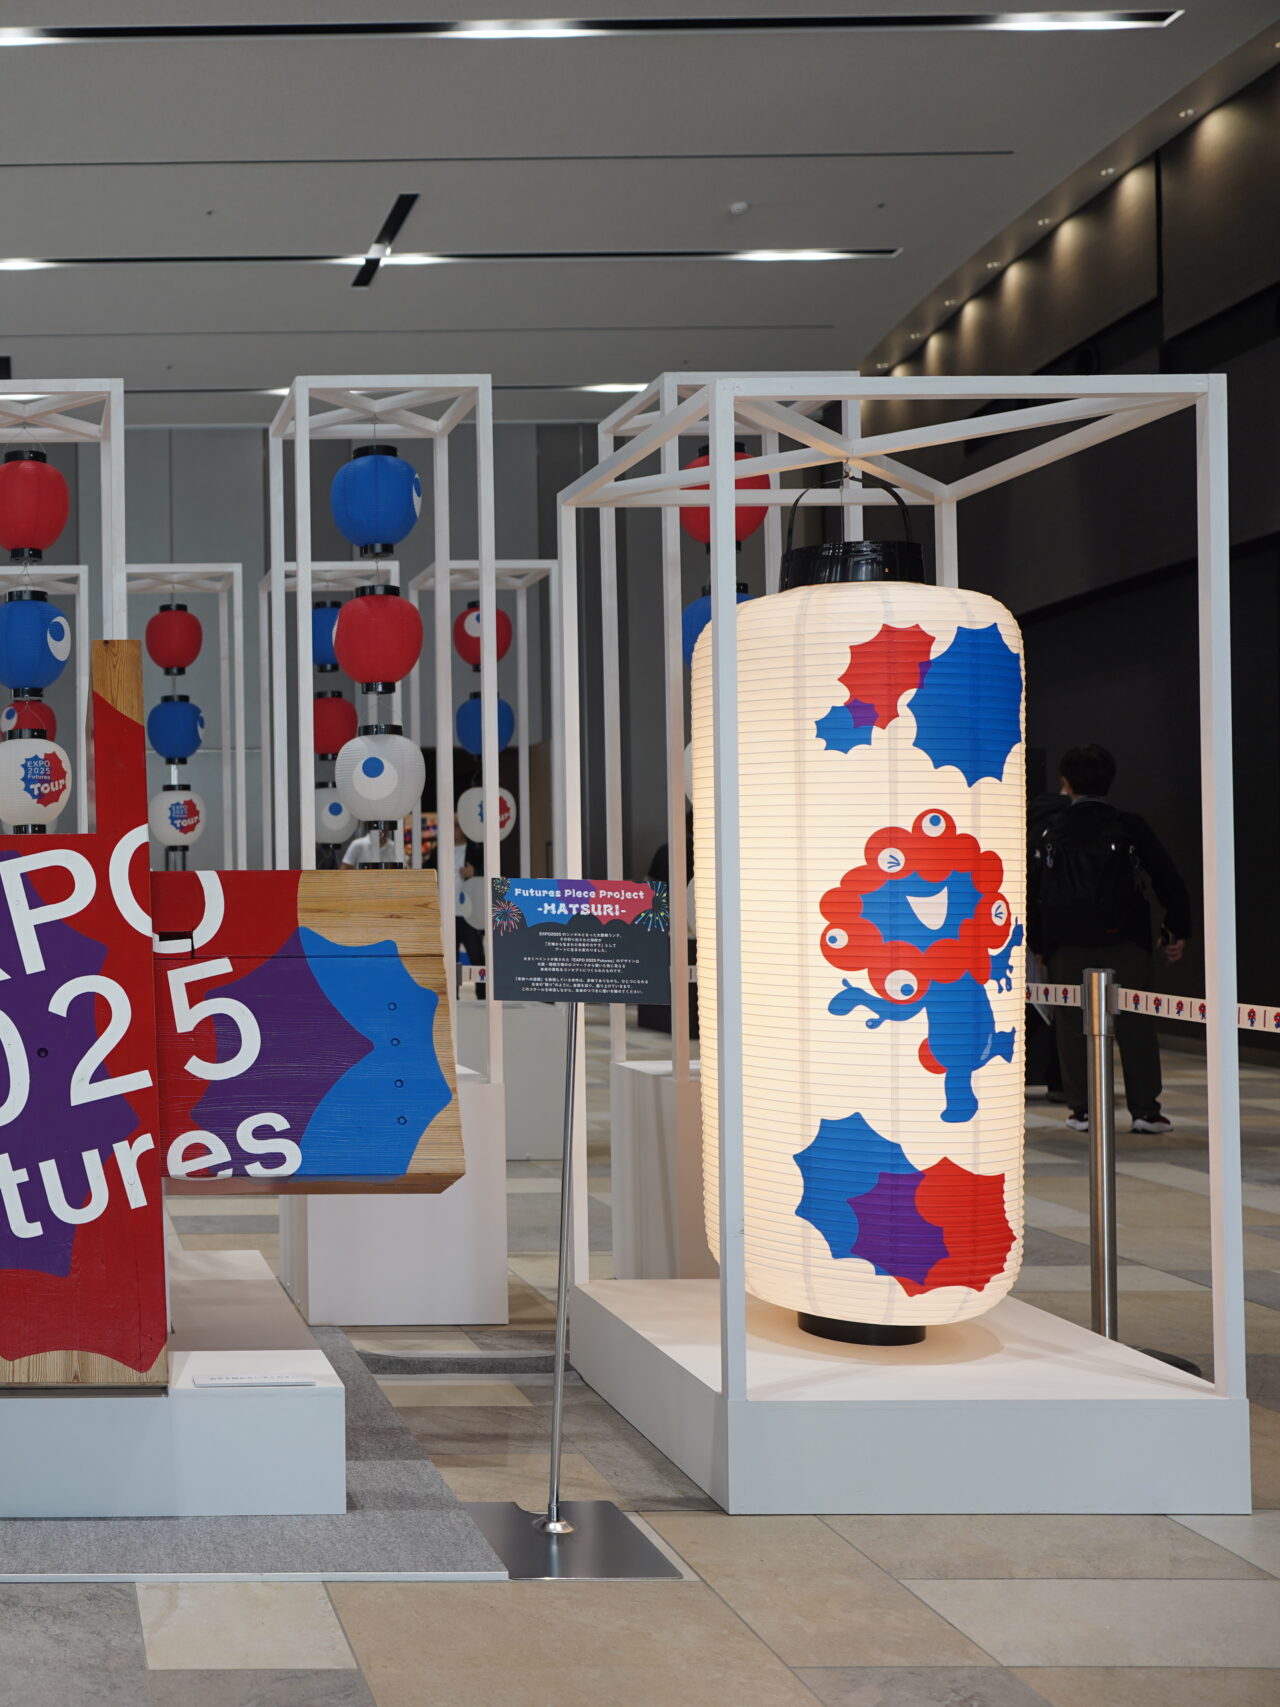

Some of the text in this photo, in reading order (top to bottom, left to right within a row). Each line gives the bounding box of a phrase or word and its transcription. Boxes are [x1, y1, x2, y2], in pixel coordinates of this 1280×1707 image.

[514, 888, 645, 900] Futures Piece Project
